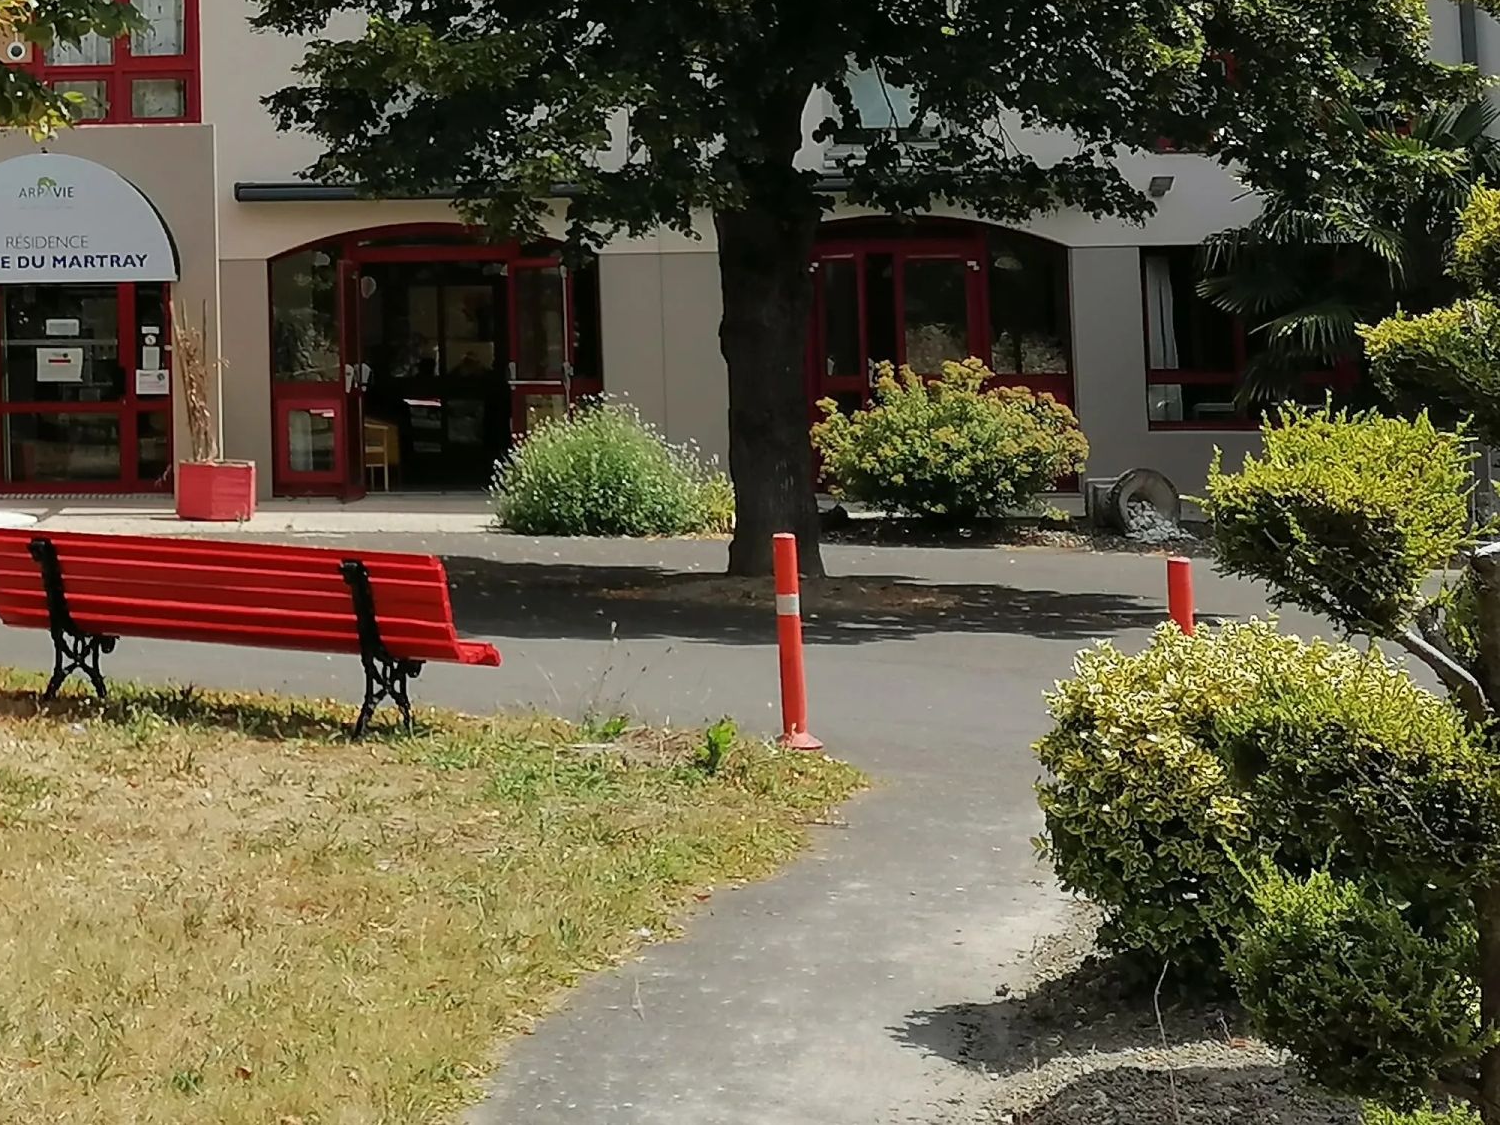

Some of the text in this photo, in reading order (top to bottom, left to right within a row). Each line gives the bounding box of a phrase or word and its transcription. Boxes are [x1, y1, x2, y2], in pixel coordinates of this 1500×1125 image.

[5, 233, 89, 249] RÉSIDENCE
[17, 255, 45, 269] DU
[52, 254, 148, 268] MARTRAY
